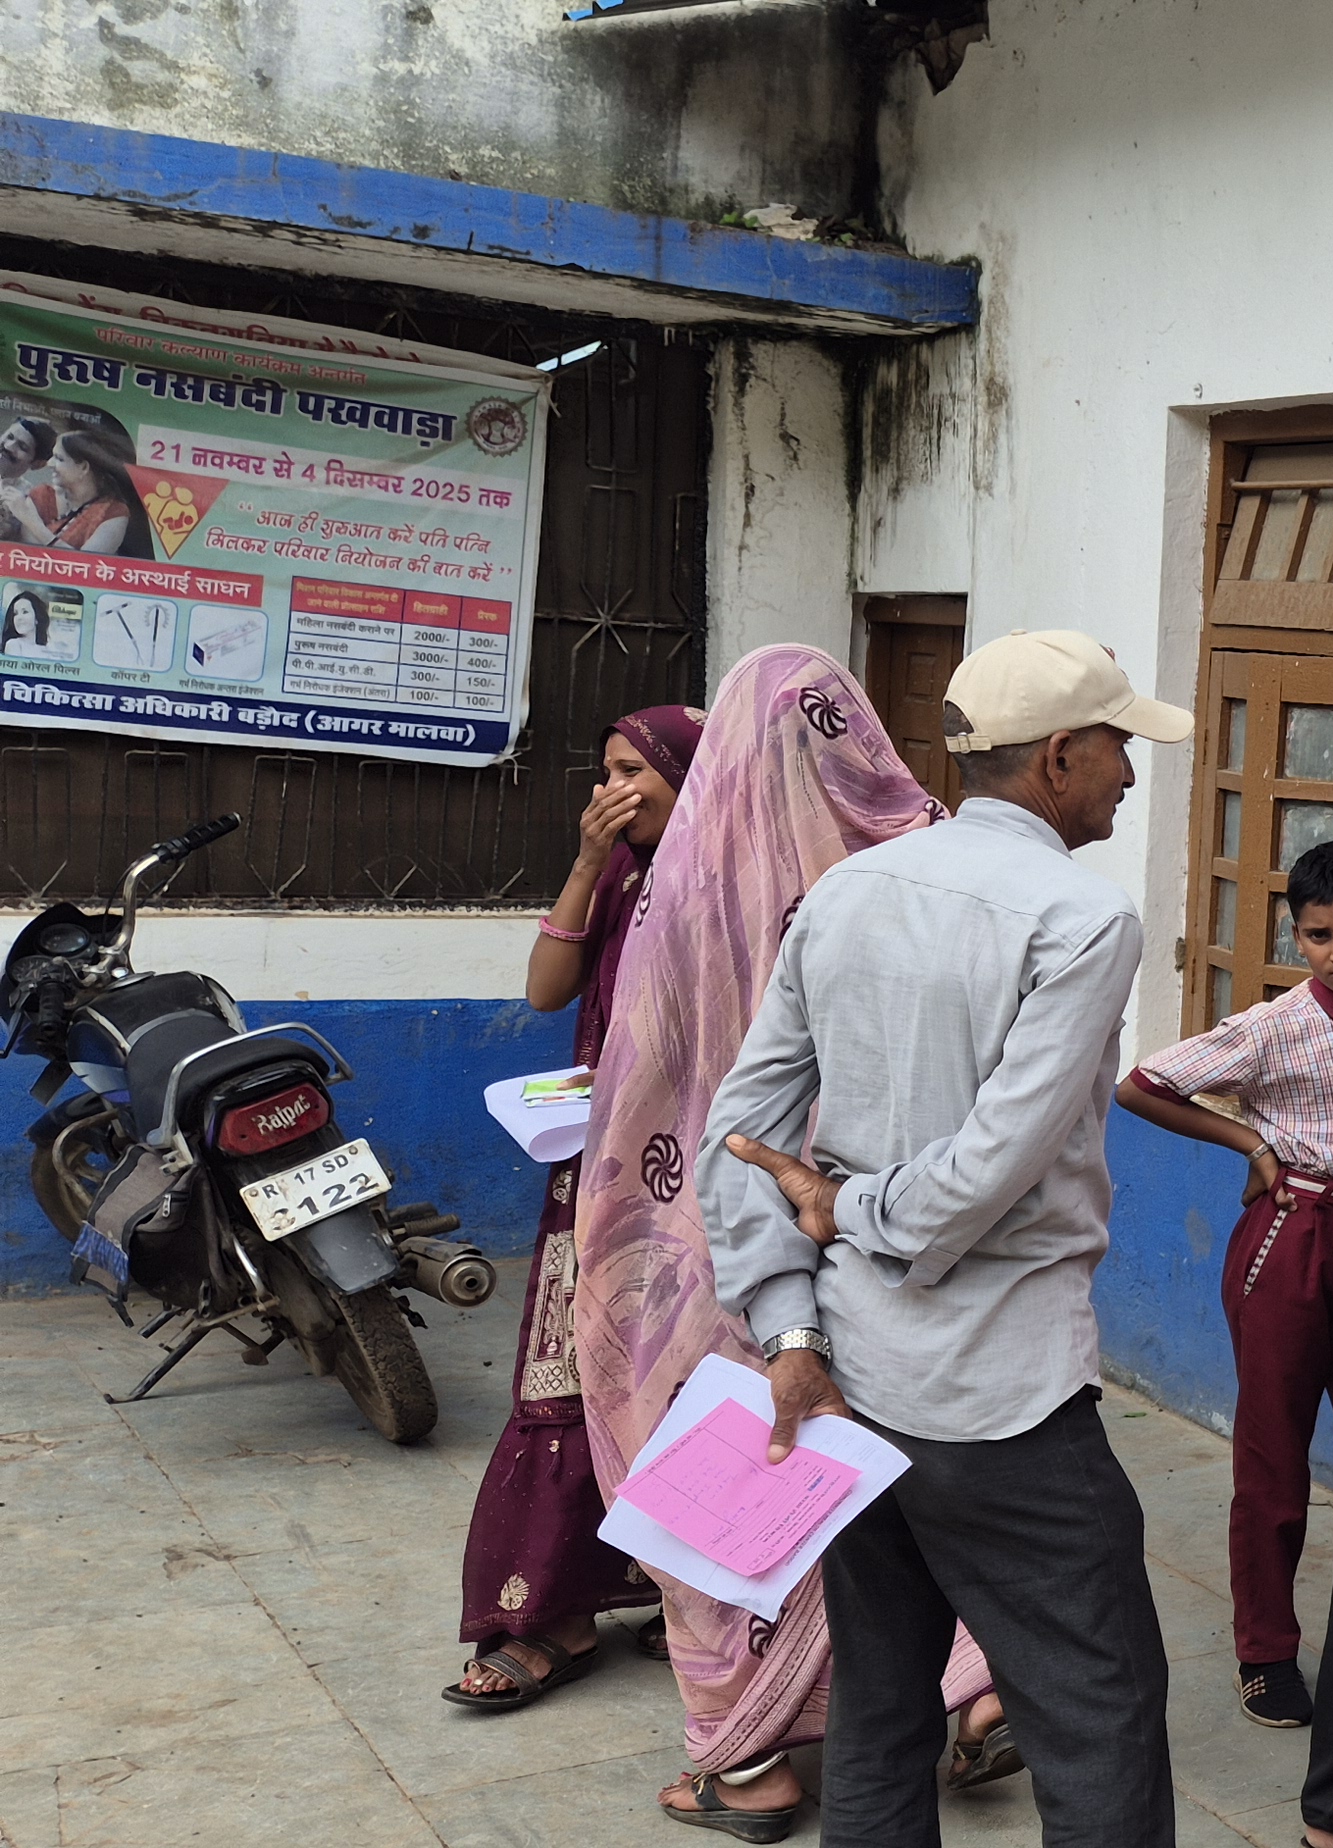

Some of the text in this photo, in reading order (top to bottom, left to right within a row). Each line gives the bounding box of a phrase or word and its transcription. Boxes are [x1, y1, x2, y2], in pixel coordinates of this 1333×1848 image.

[95, 327, 368, 386] परिवार कल्याण कार्यक्रम अन्तर्गत
[135, 364, 288, 416] नसबंदी
[296, 390, 458, 448] पखवाड़ा
[151, 440, 512, 509] 21 नवम्बर से 4 दिसम्बर 2025 तक
[256, 510, 491, 554] आज ही करें पति पत्नि
[205, 526, 493, 583] मिलकर परिवार नियोजन की बात करें
[9, 549, 90, 580] नियोजन
[95, 560, 115, 582] के
[121, 568, 190, 595] अस्थाई
[196, 577, 251, 600] साधन
[297, 616, 395, 637] महिला नसबंदी कराने पर
[414, 630, 451, 643] 2000/-
[469, 637, 498, 648] 300/-
[412, 651, 449, 664] 3000/-
[467, 657, 497, 669] 400/-
[20, 660, 81, 676] ओरल पिल्स
[110, 670, 151, 684] कॉपर टी
[411, 671, 440, 683] 300/-
[467, 677, 496, 688] 150/-
[411, 690, 439, 701] 100/-
[466, 696, 495, 707] 100/-
[2, 680, 115, 711] चिकित्सा
[119, 695, 233, 722] अधिकारी
[305, 709, 384, 736] (आगर
[388, 721, 477, 746] मालवा)
[294, 1167, 316, 1186] 17
[321, 1154, 349, 1174] SD
